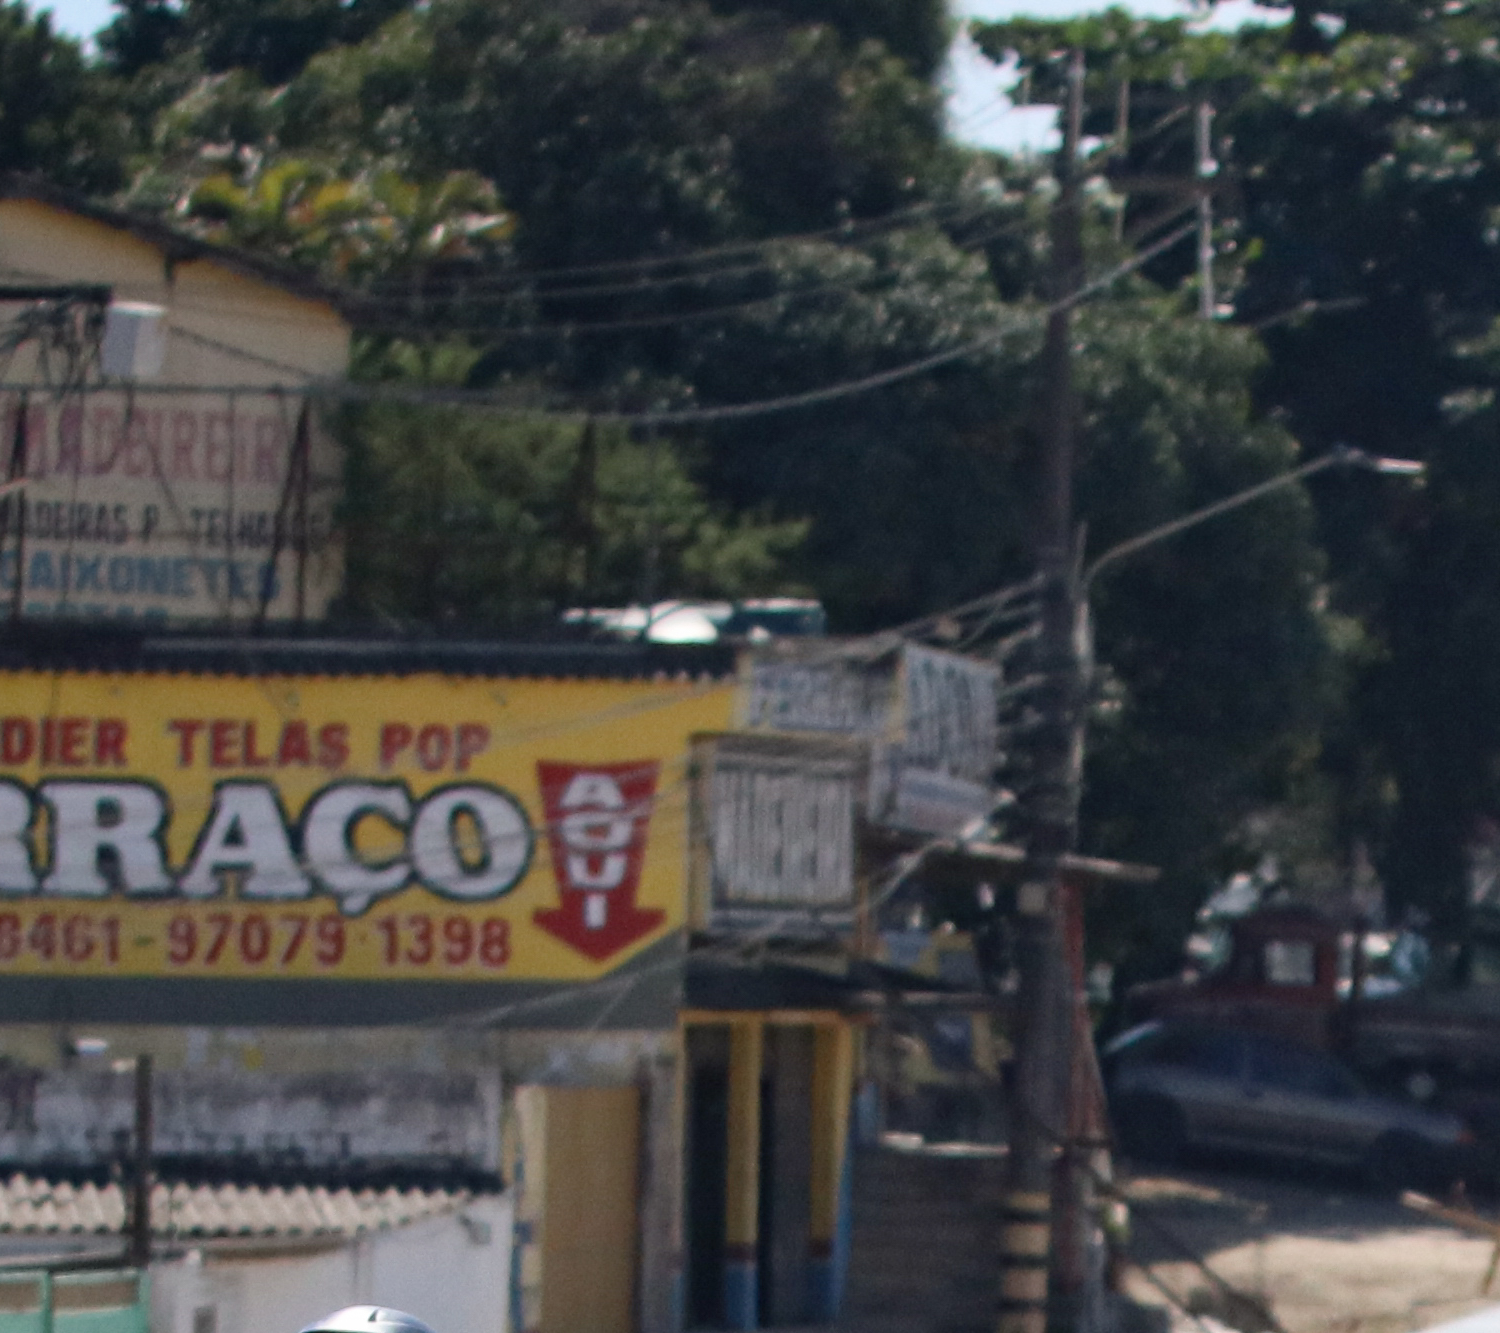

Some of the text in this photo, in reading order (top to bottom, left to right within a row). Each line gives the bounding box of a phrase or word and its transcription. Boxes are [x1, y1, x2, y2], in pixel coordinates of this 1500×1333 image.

[0, 405, 312, 482] MADEIREIR
[168, 719, 351, 769] TELAS
[380, 722, 492, 772] POP
[560, 772, 634, 930] AQUI
[167, 914, 347, 966] 97079
[381, 916, 513, 968] 1398
